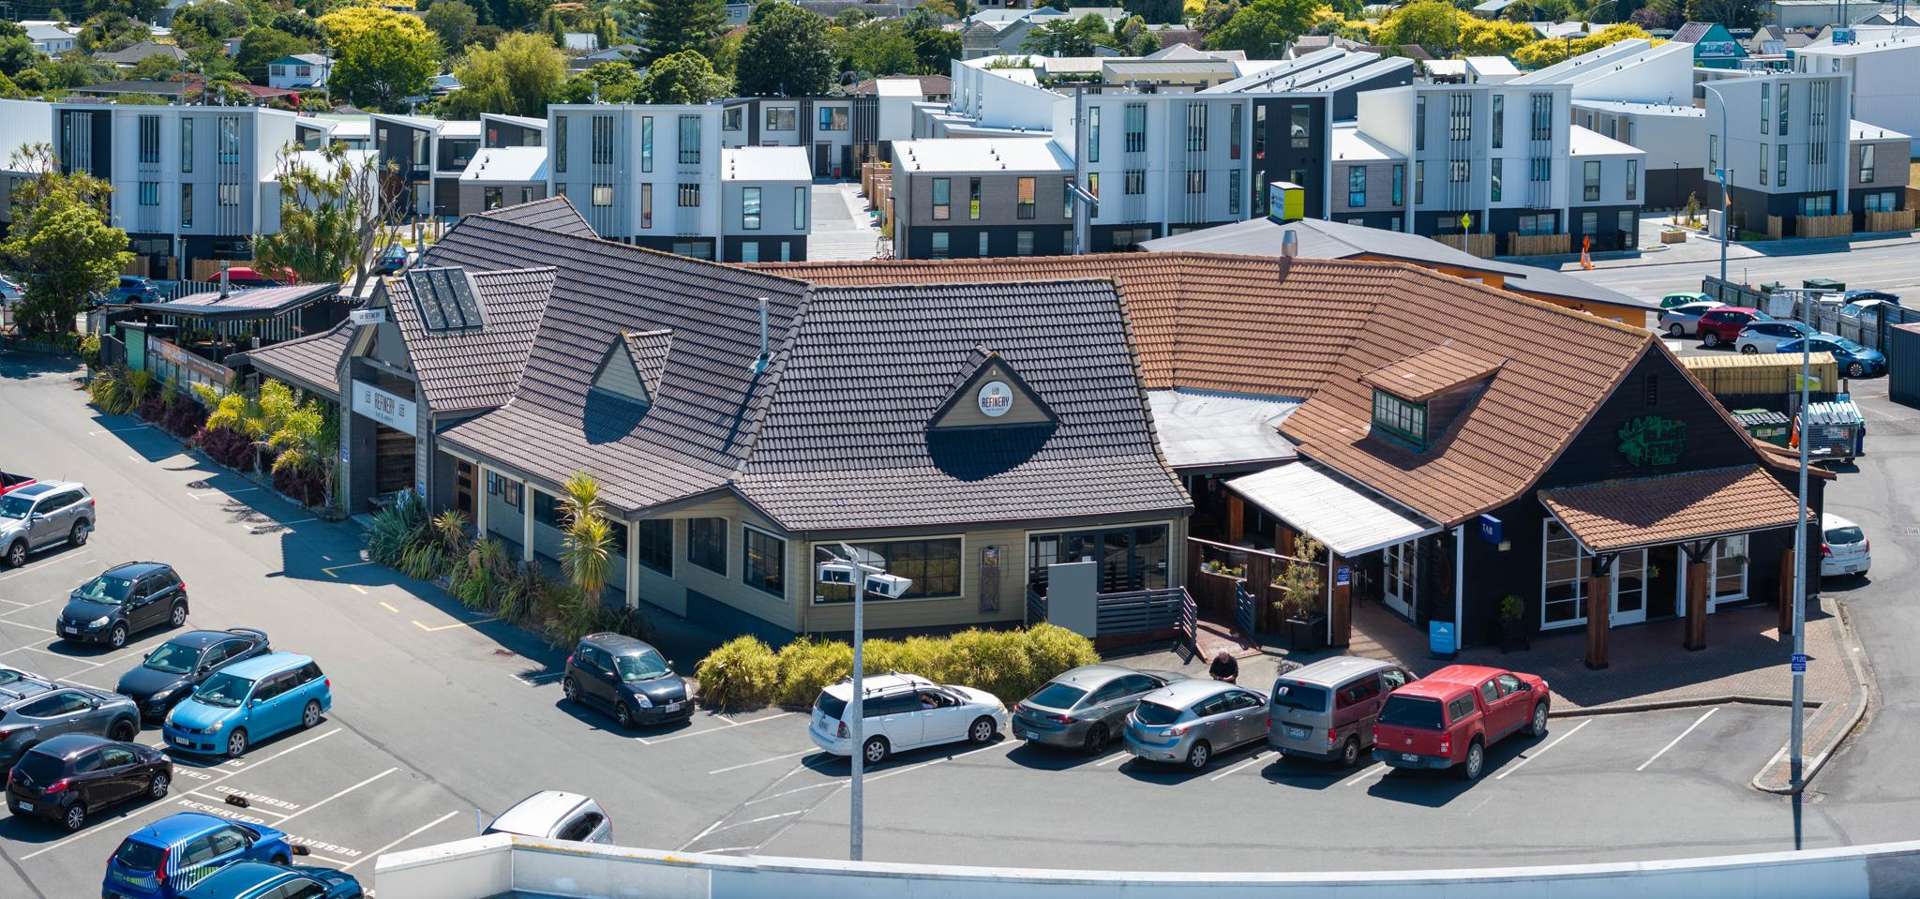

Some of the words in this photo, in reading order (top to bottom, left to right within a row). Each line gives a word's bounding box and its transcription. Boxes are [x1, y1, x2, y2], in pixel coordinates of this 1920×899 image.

[374, 392, 395, 416] REFINERY
[981, 396, 1010, 408] REFINERY
[214, 785, 300, 810] RESERVED
[178, 799, 265, 824] RESERVED
[287, 833, 362, 857] RESERV
